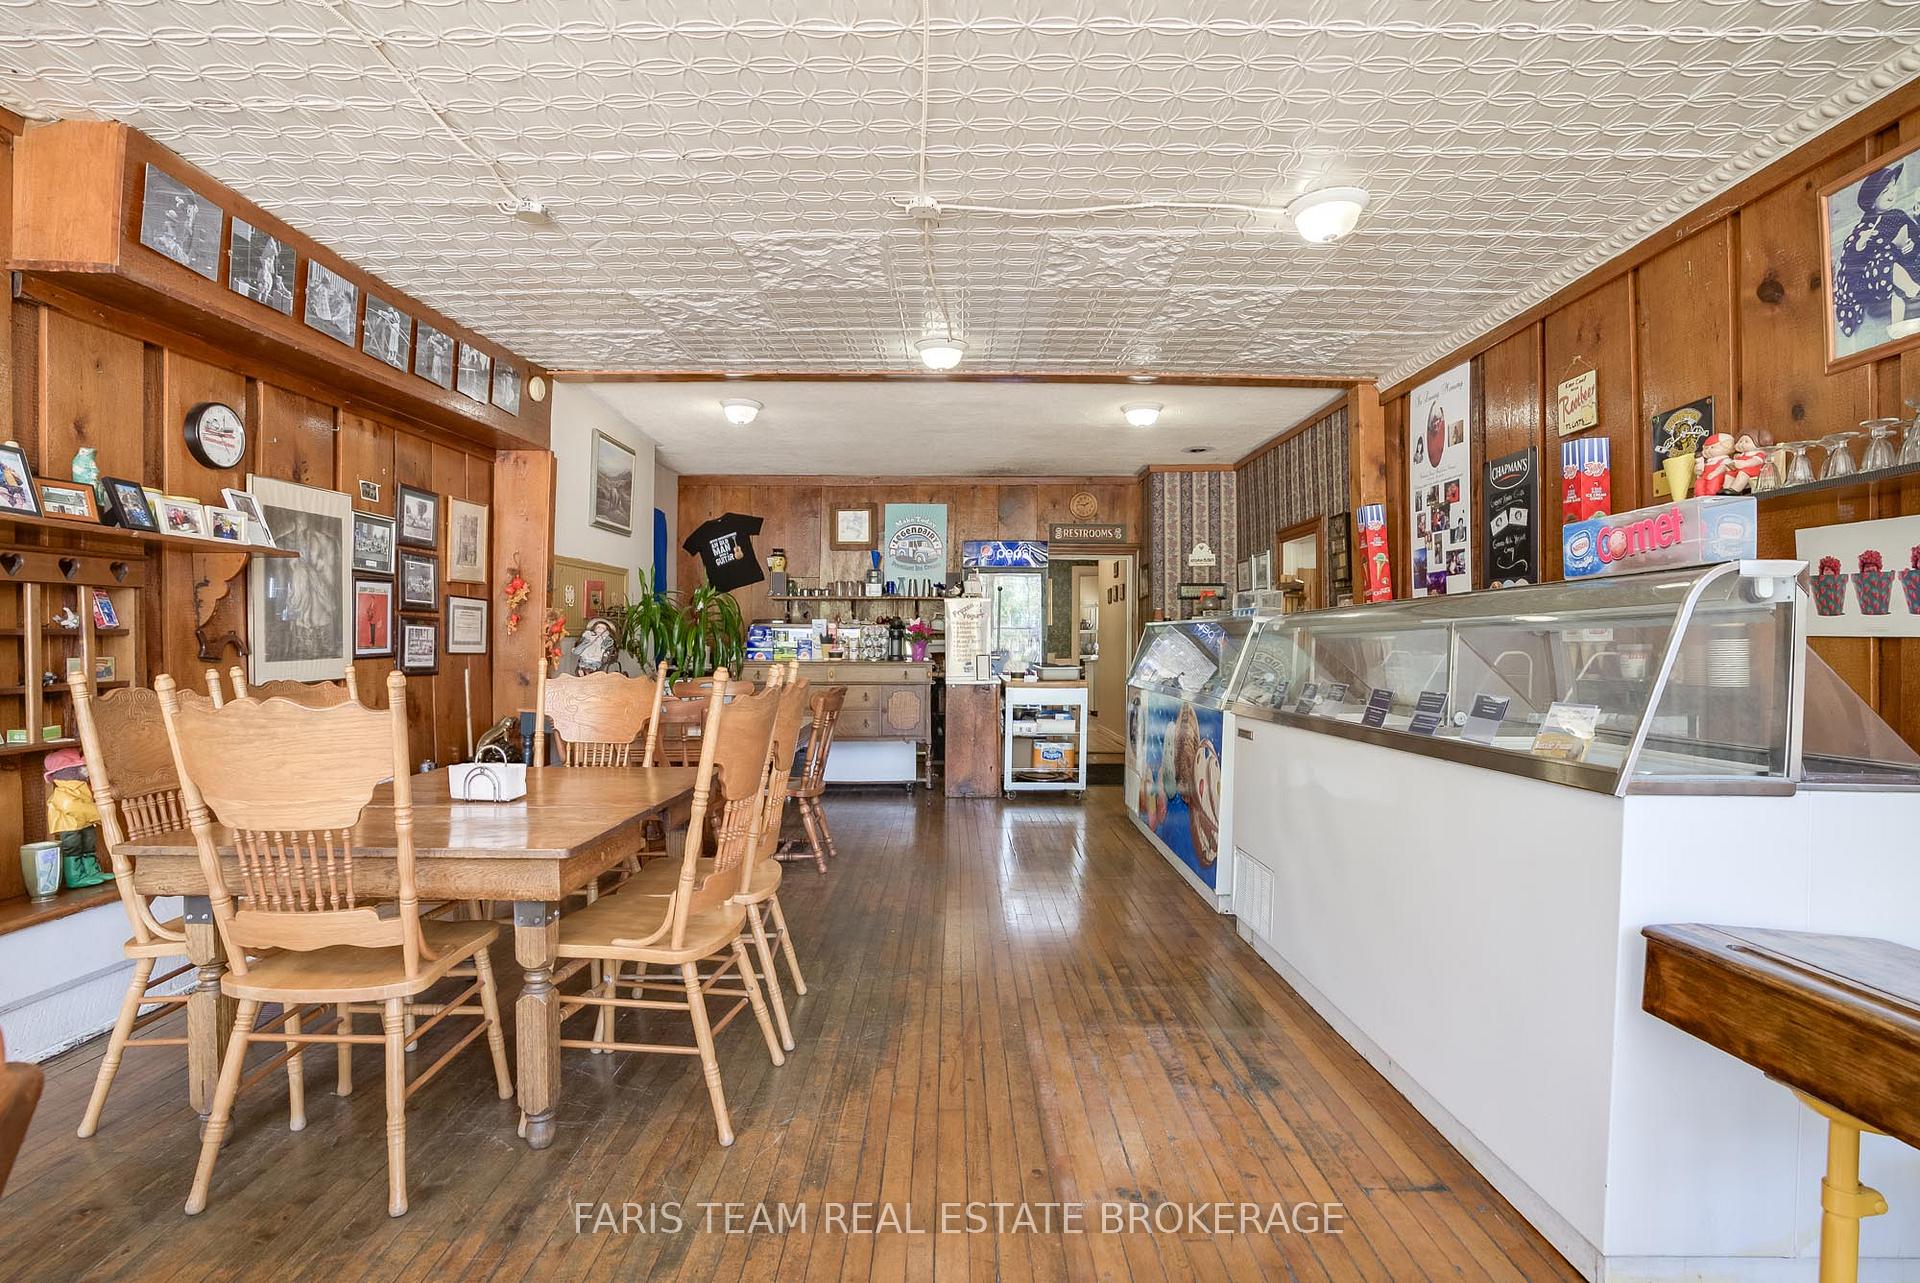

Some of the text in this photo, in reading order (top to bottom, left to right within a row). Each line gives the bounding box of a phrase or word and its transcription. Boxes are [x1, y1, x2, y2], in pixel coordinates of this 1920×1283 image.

[1492, 458, 1528, 480] CHAPMAN'S
[895, 516, 937, 528] Make Today
[1063, 528, 1113, 538] RESTROOMS
[1596, 506, 1683, 564] Cornet
[712, 544, 731, 557] MAN
[996, 548, 1031, 561] pepsi
[715, 553, 735, 567] GUITAR
